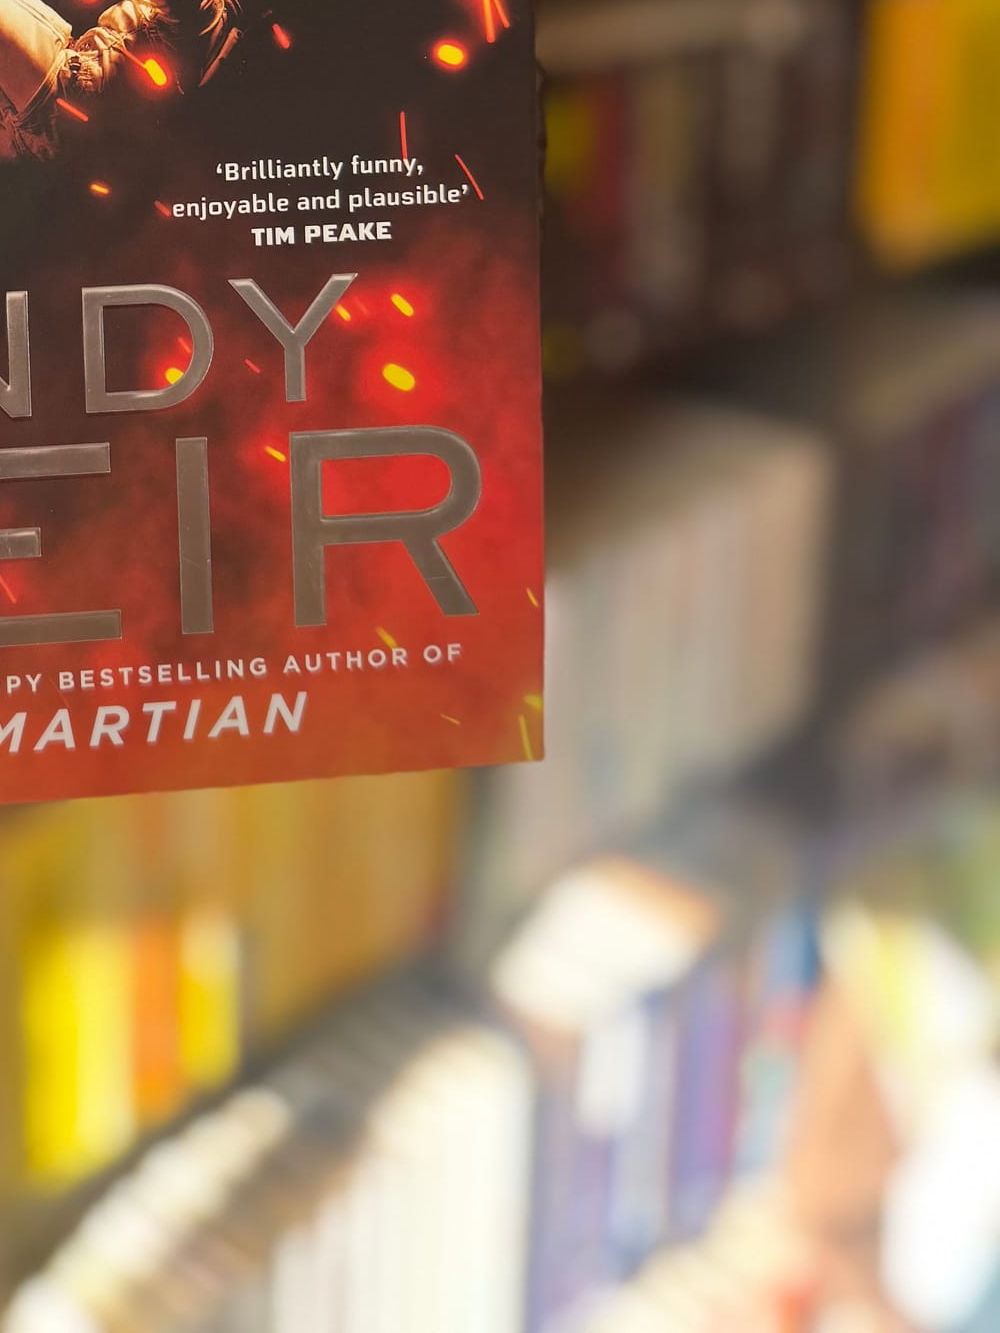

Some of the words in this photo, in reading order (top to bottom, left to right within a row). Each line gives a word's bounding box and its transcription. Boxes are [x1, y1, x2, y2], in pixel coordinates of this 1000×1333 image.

[216, 156, 343, 180] ‘Brilliantly
[351, 155, 423, 177] funny,
[172, 193, 289, 220] enjoyable
[297, 189, 341, 211] and
[349, 184, 468, 212] plausible’
[251, 226, 295, 246] TIM
[304, 221, 392, 243] PEAKE
[58, 657, 267, 690] BESTSELLING
[283, 647, 408, 675] AUTHOR
[423, 643, 462, 664] OF
